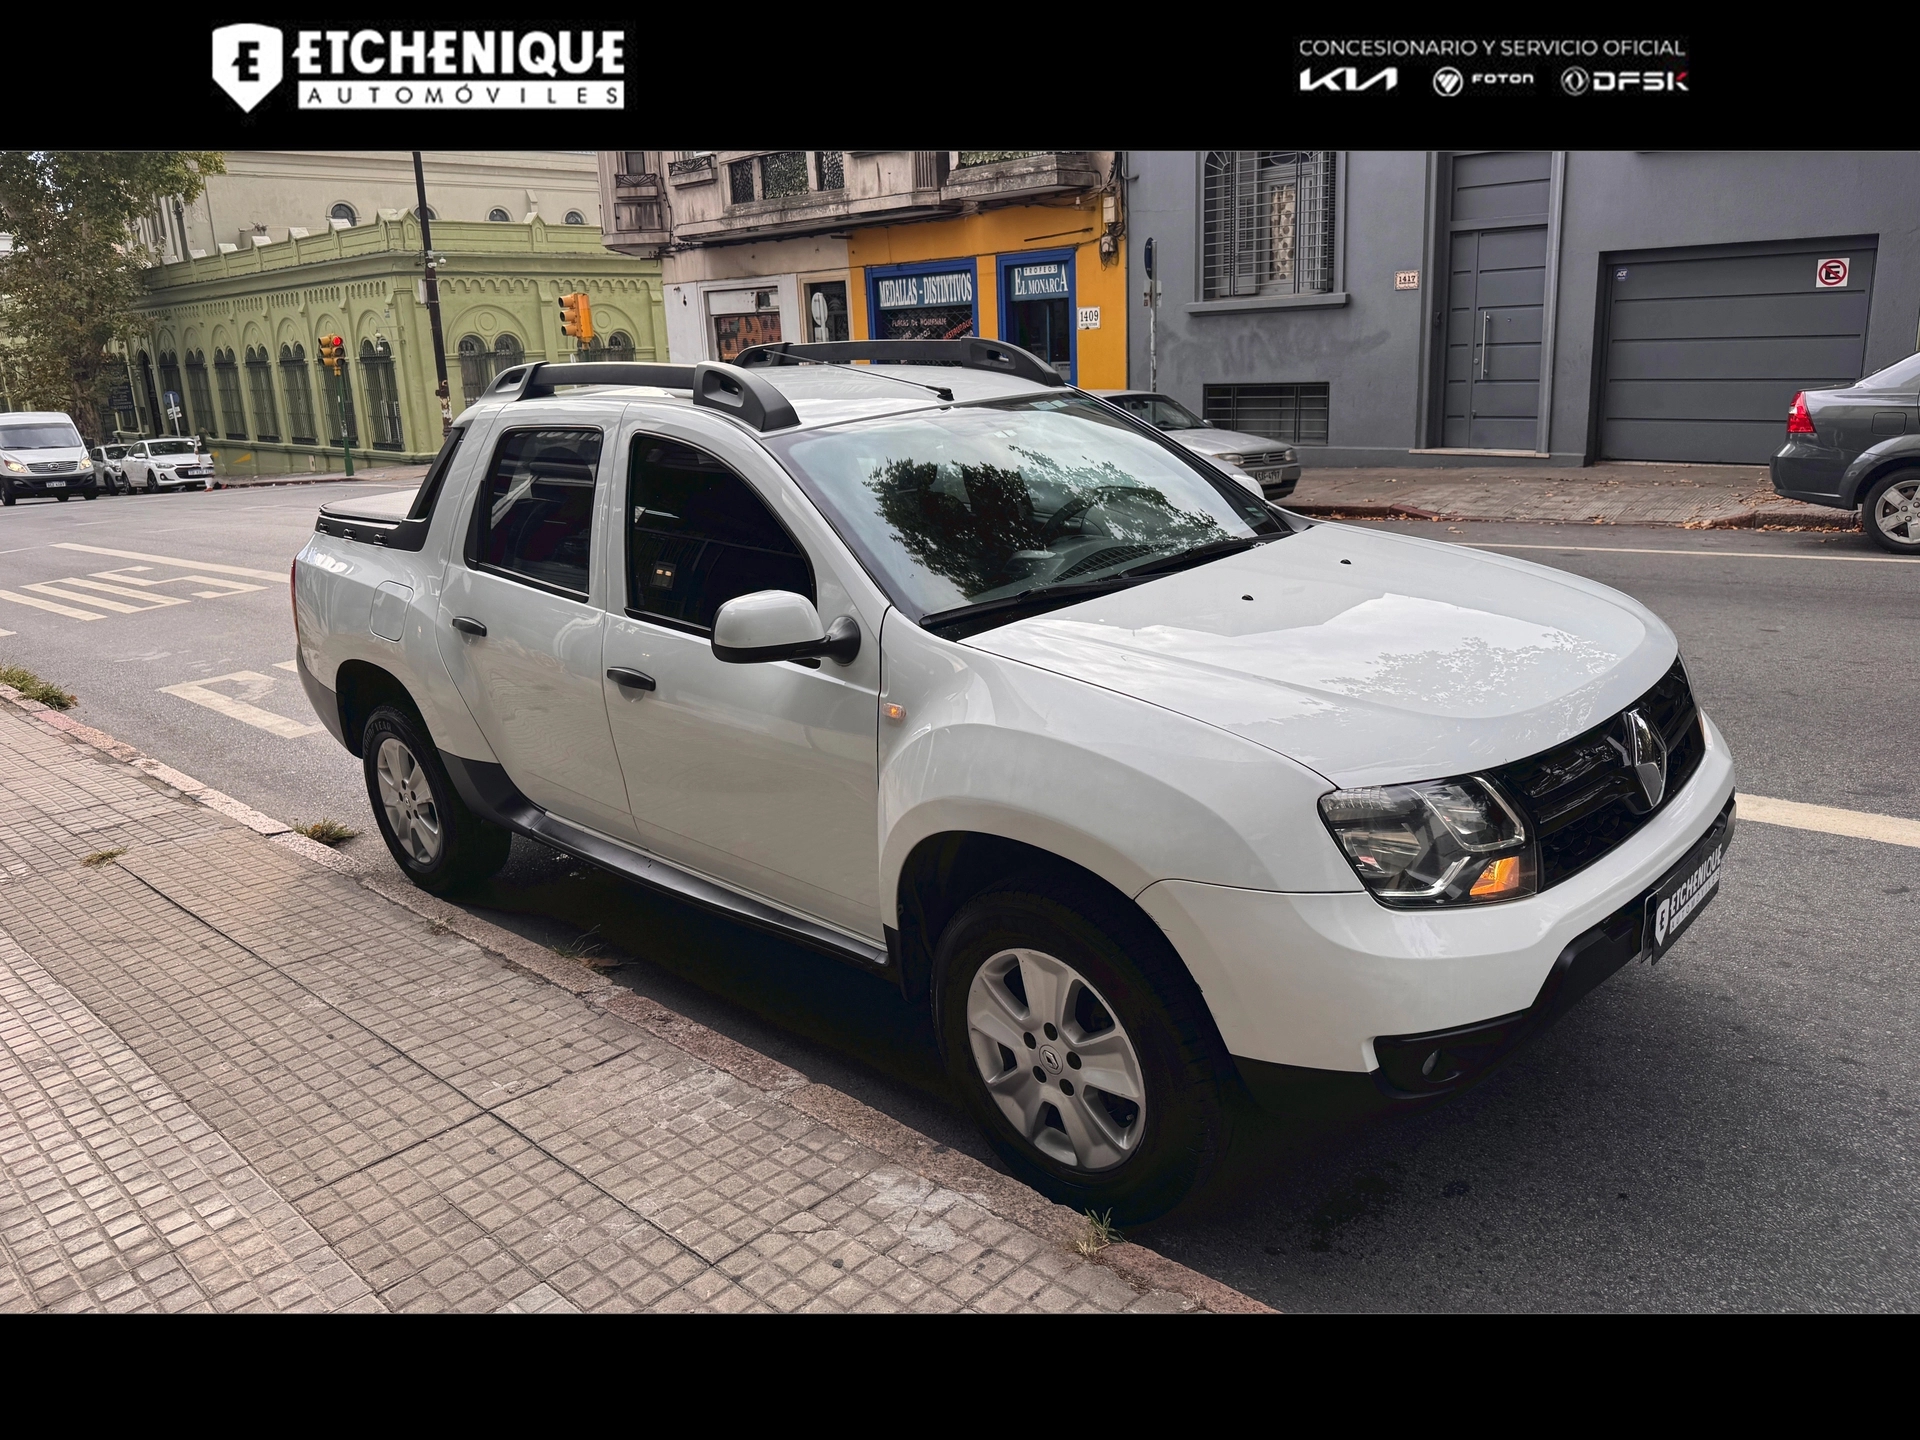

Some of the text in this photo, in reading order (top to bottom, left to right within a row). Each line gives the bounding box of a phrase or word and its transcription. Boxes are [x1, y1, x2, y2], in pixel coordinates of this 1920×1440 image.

[1014, 264, 1069, 295] EL MONARCA
[1024, 265, 1057, 275] TROFEOS
[1398, 275, 1416, 283] 1417
[879, 277, 918, 307] MEDALLAS
[923, 272, 973, 305] DISTINTIVOS
[1080, 310, 1099, 322] 1409
[1669, 843, 1723, 914] ETCHENIQUE
